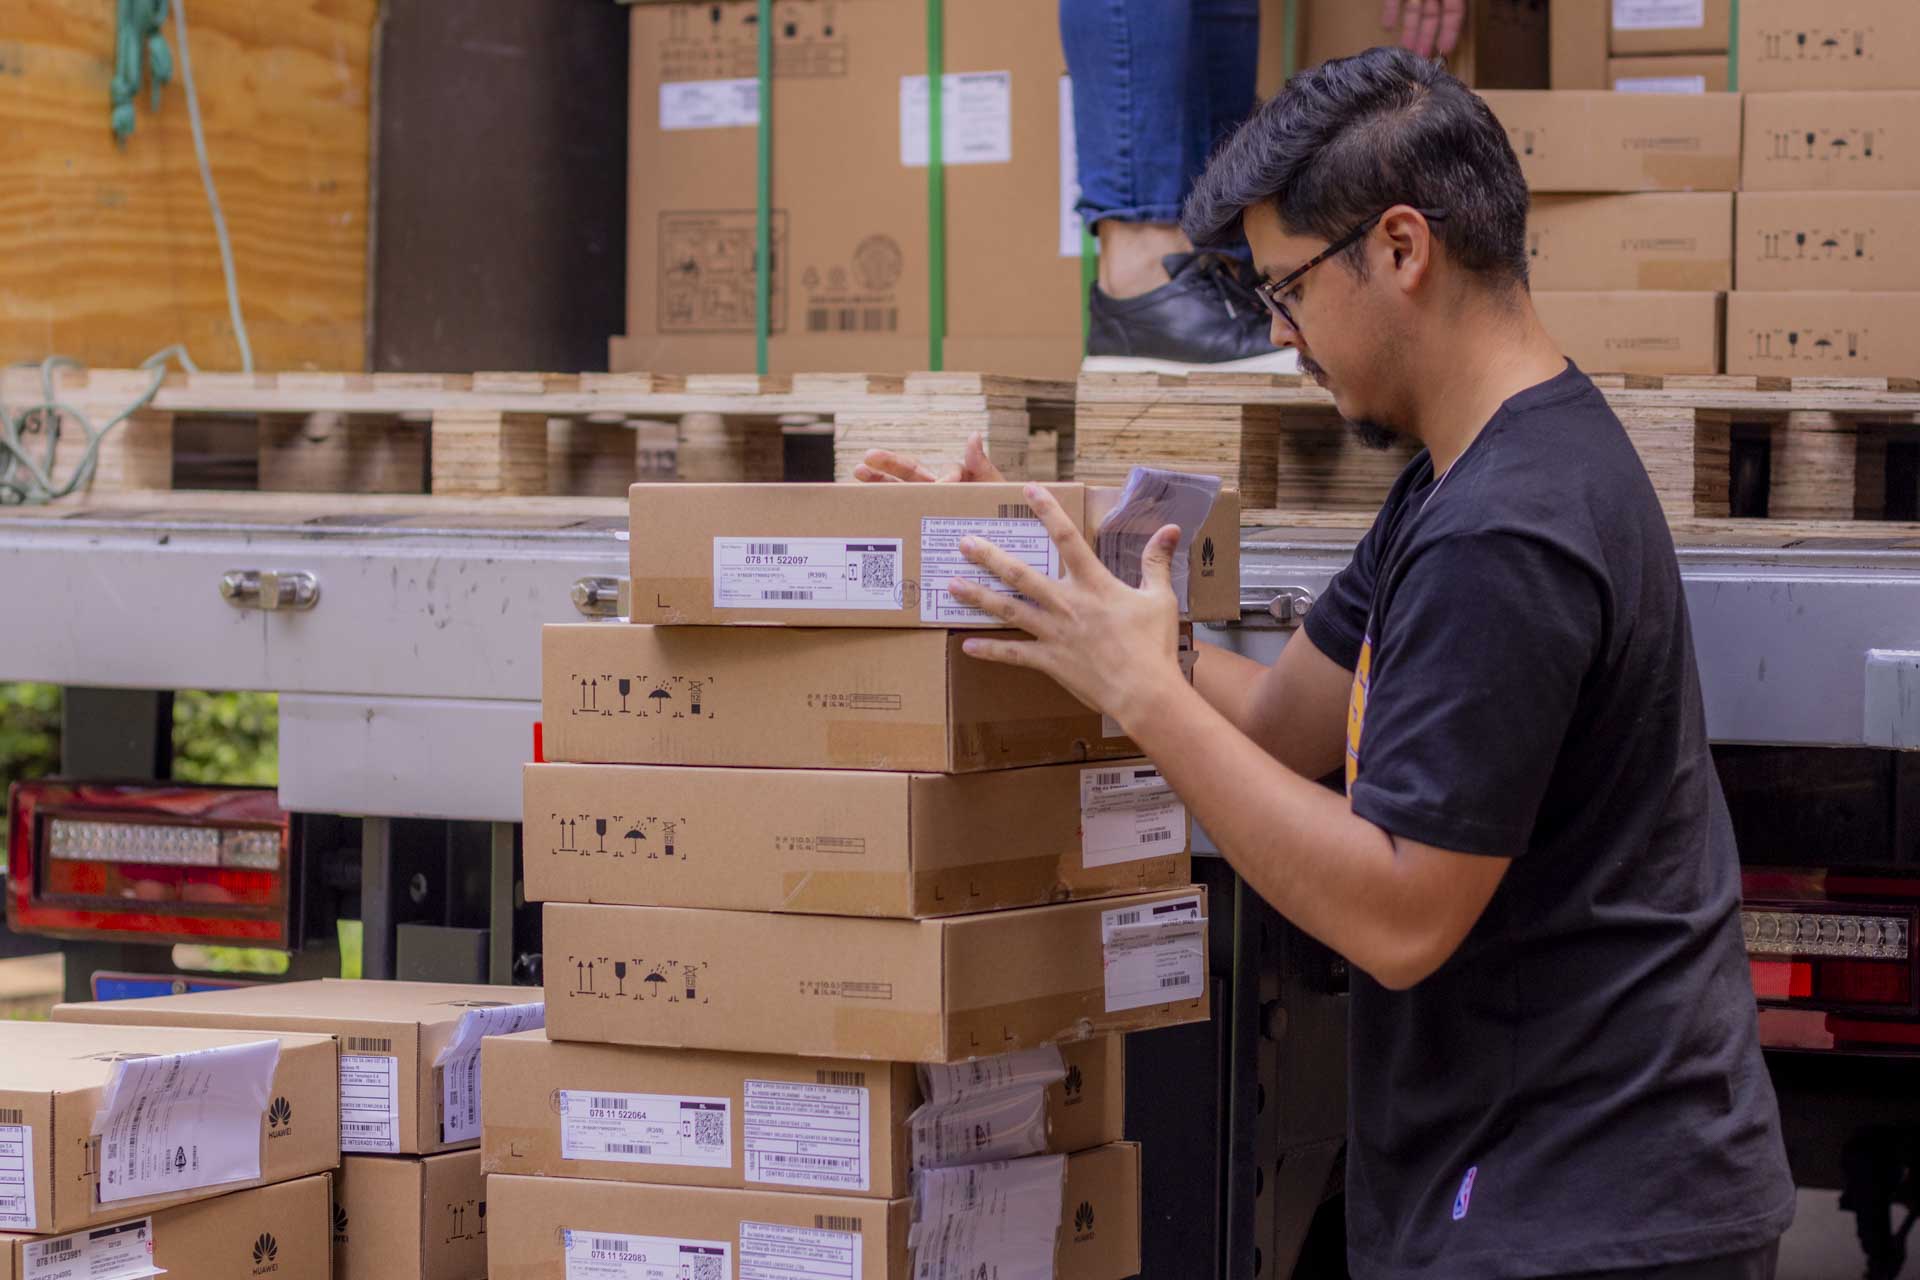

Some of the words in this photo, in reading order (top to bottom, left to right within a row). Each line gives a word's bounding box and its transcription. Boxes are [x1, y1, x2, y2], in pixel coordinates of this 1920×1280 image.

[746, 556, 761, 564] 078
[764, 556, 774, 564] 11
[777, 556, 808, 564] 522097
[589, 1109, 604, 1117] 078
[606, 1110, 615, 1118] 11
[618, 1110, 646, 1120] 522064
[269, 1128, 292, 1139] HUAWEI
[812, 1173, 840, 1182] INTEGRADO
[36, 1257, 48, 1267] 078
[50, 1254, 57, 1264] 11
[592, 1250, 605, 1259] 078
[607, 1251, 616, 1259] 11
[619, 1252, 647, 1262] 522083
[252, 1263, 278, 1276] HUAWEI
